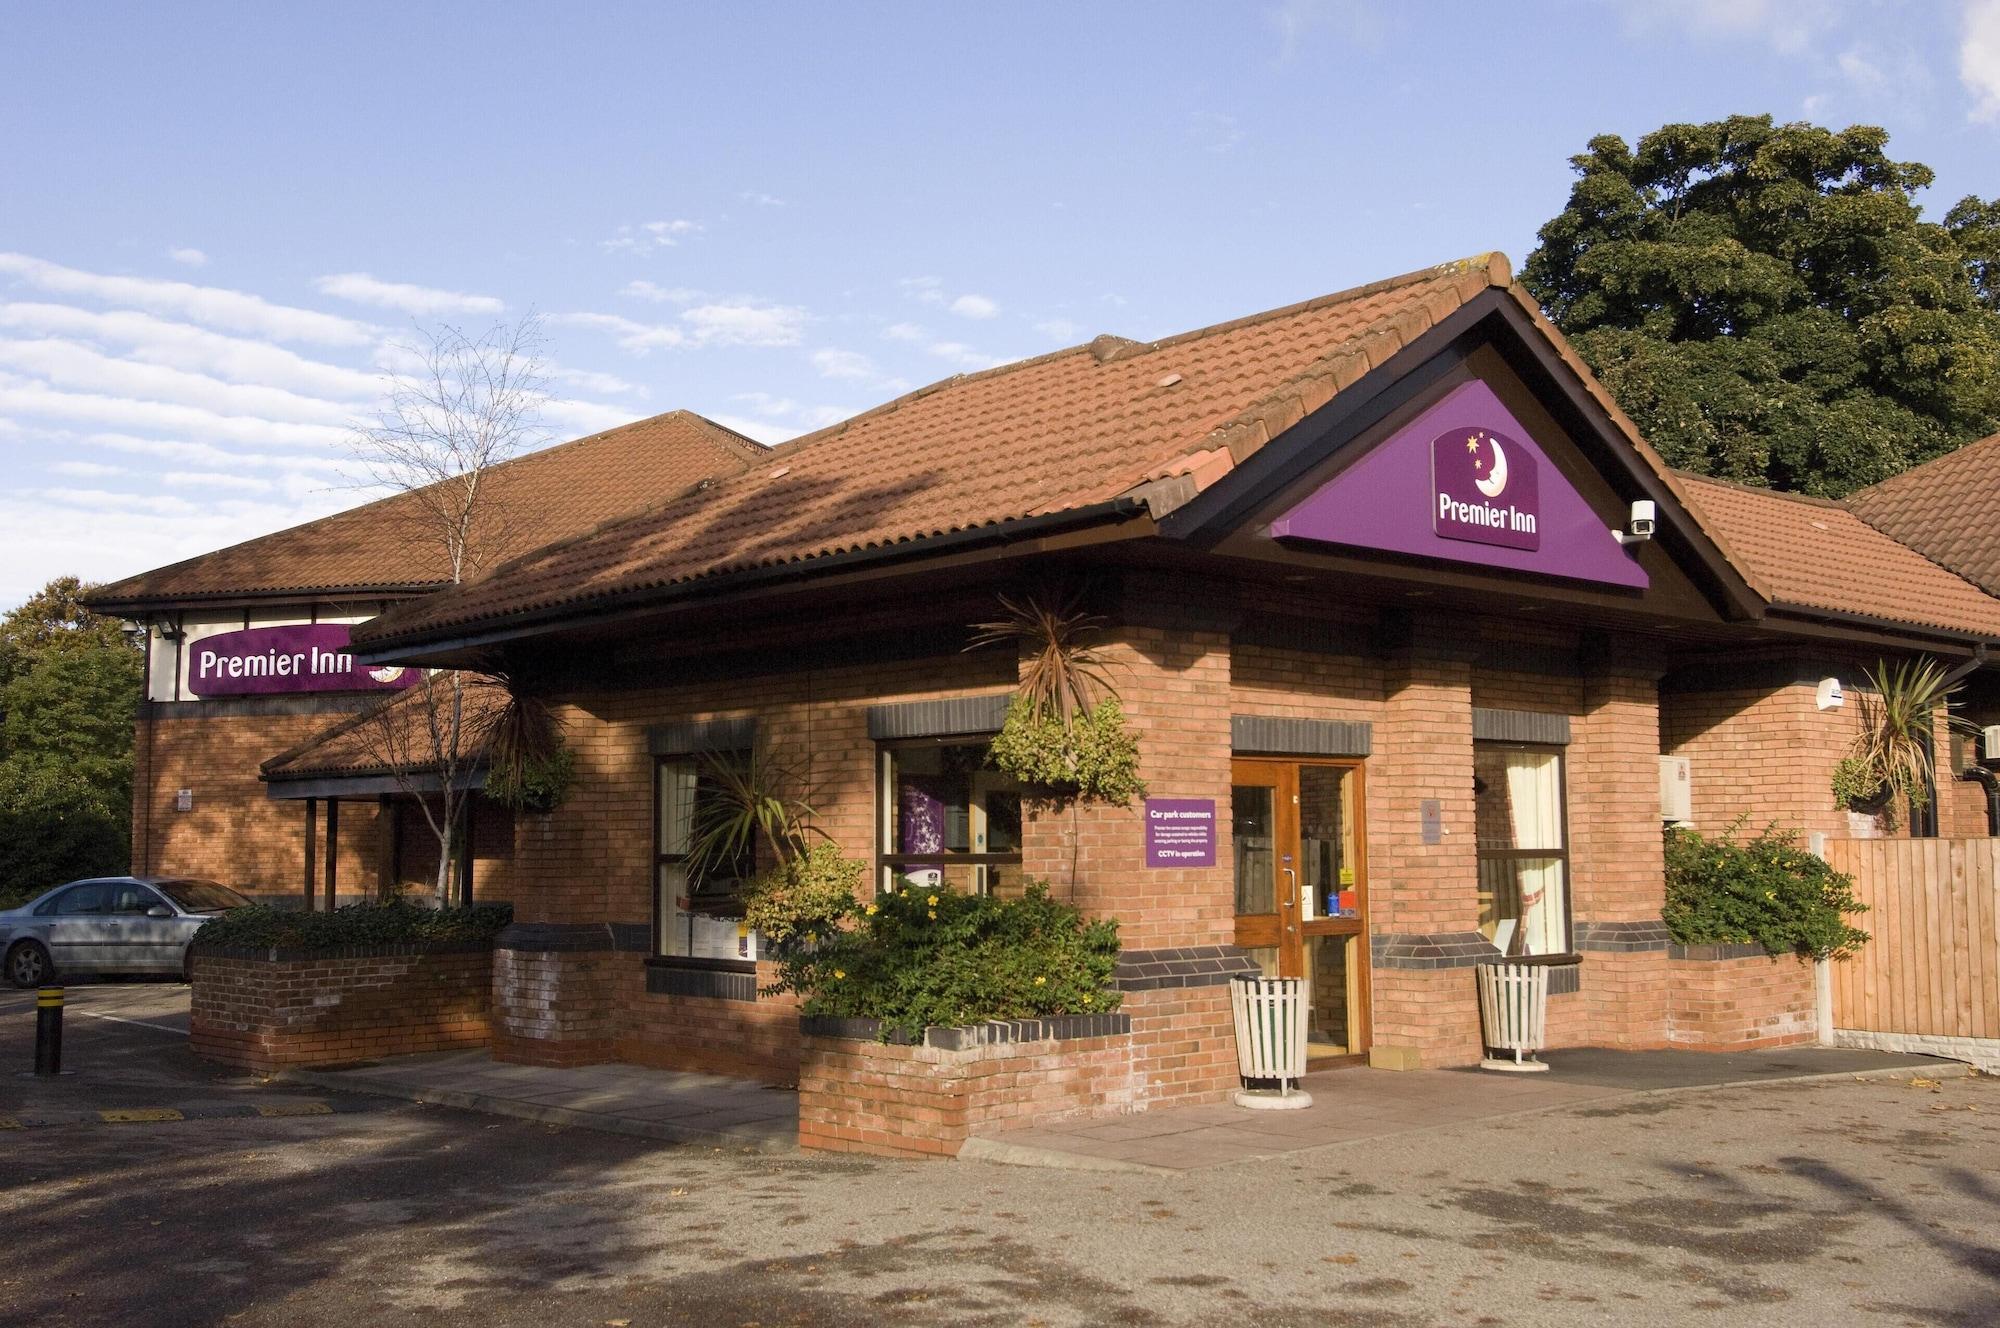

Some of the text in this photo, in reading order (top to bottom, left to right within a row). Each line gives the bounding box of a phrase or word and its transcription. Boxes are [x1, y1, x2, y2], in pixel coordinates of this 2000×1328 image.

[1440, 493, 1537, 534] Premier Inn
[200, 646, 353, 679] Premier Inn
[1150, 810, 1211, 820] Car park customers
[1158, 850, 1175, 858] CCTV
[1181, 850, 1205, 859] operation
